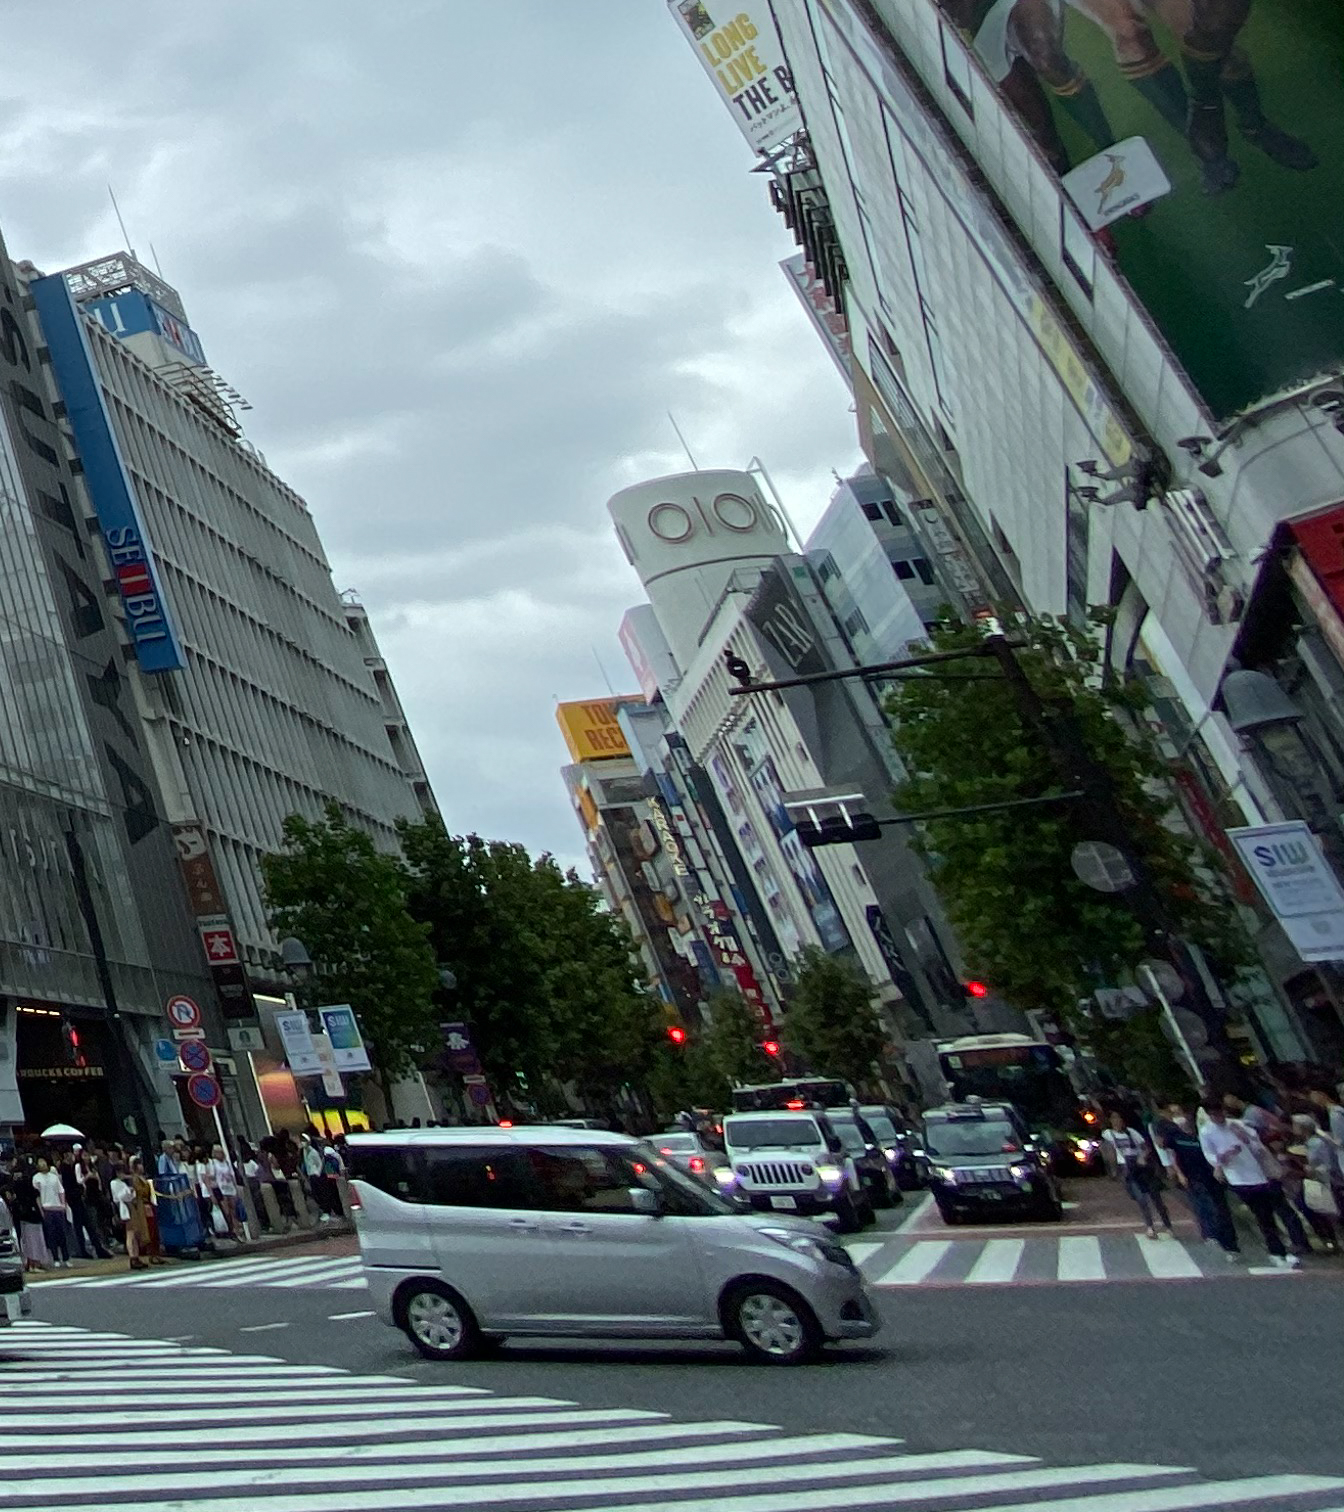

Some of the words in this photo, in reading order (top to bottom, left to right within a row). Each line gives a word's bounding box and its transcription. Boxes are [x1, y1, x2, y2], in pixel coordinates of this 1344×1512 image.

[700, 13, 758, 67] LONG
[716, 45, 768, 95] LIVE
[733, 76, 779, 120] THE
[773, 65, 795, 94] B
